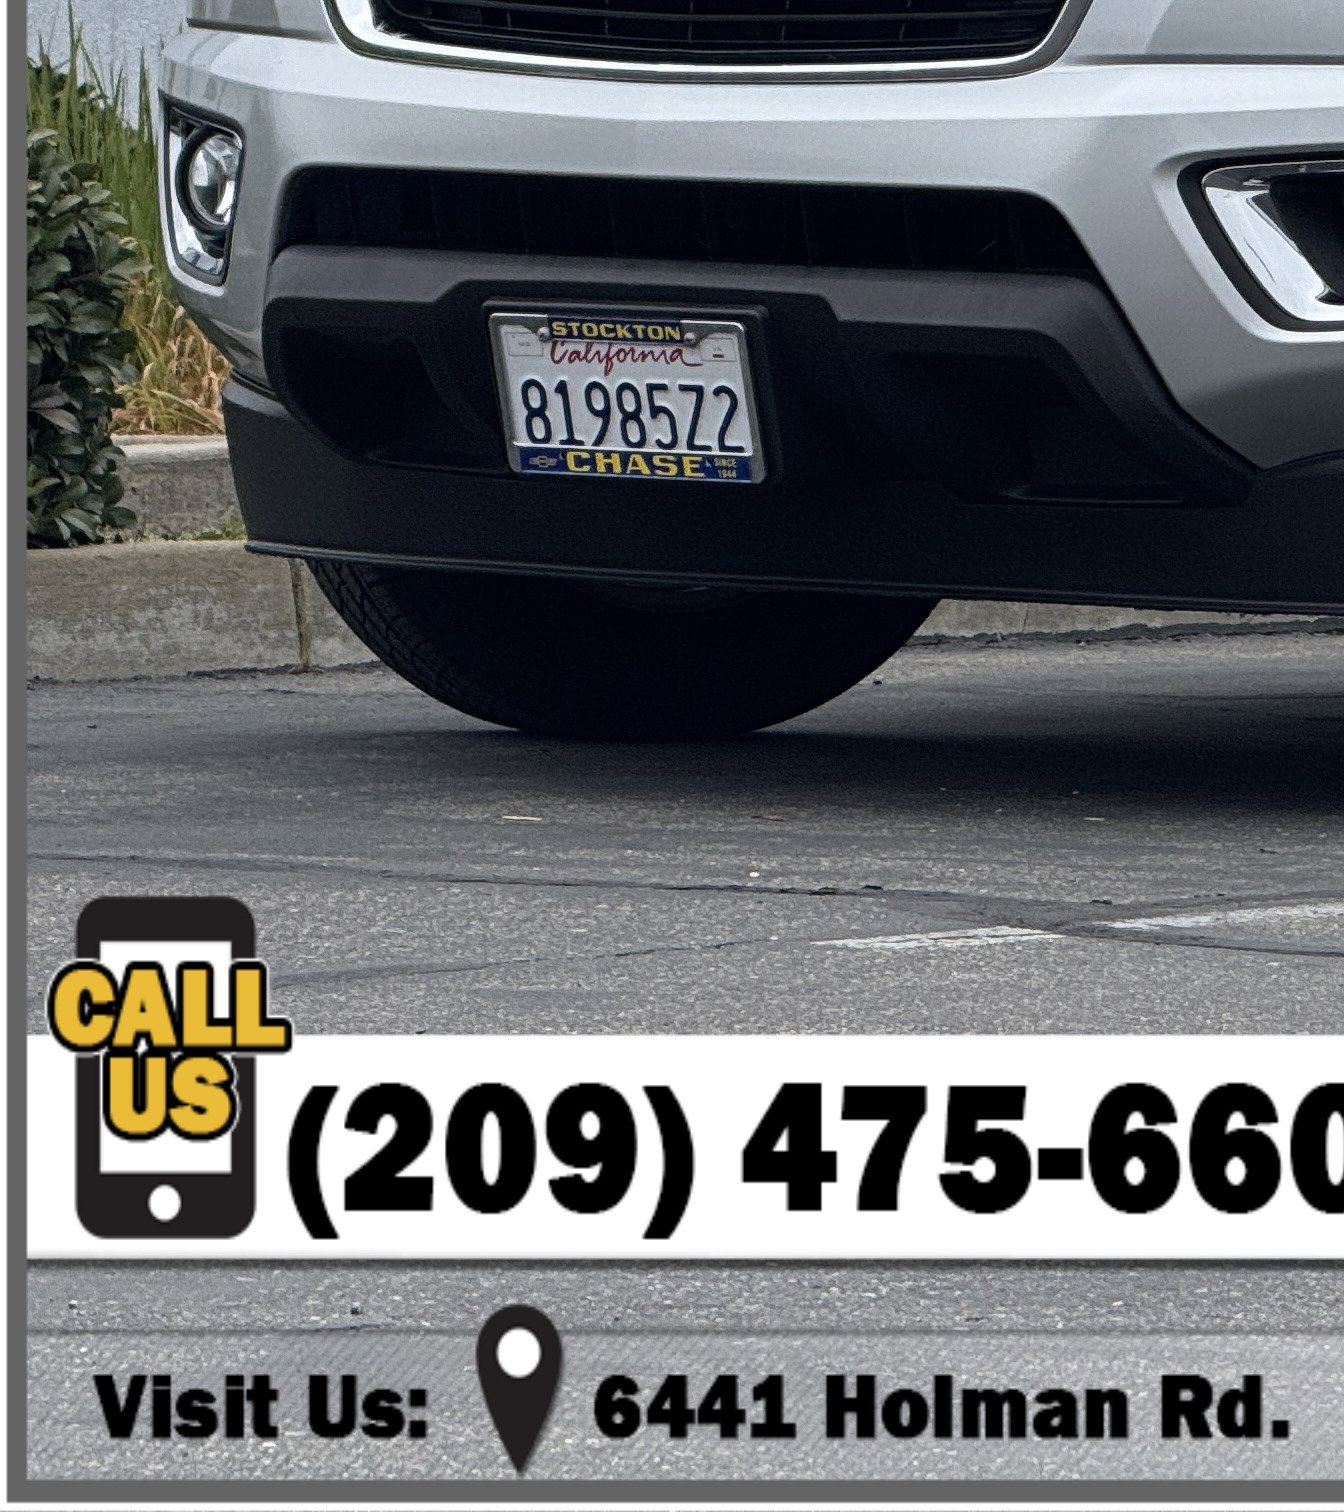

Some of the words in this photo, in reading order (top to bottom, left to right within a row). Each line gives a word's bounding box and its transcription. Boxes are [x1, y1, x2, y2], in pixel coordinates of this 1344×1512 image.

[551, 320, 682, 341] STOCKTON
[550, 341, 704, 377] California
[565, 451, 706, 478] CHASE
